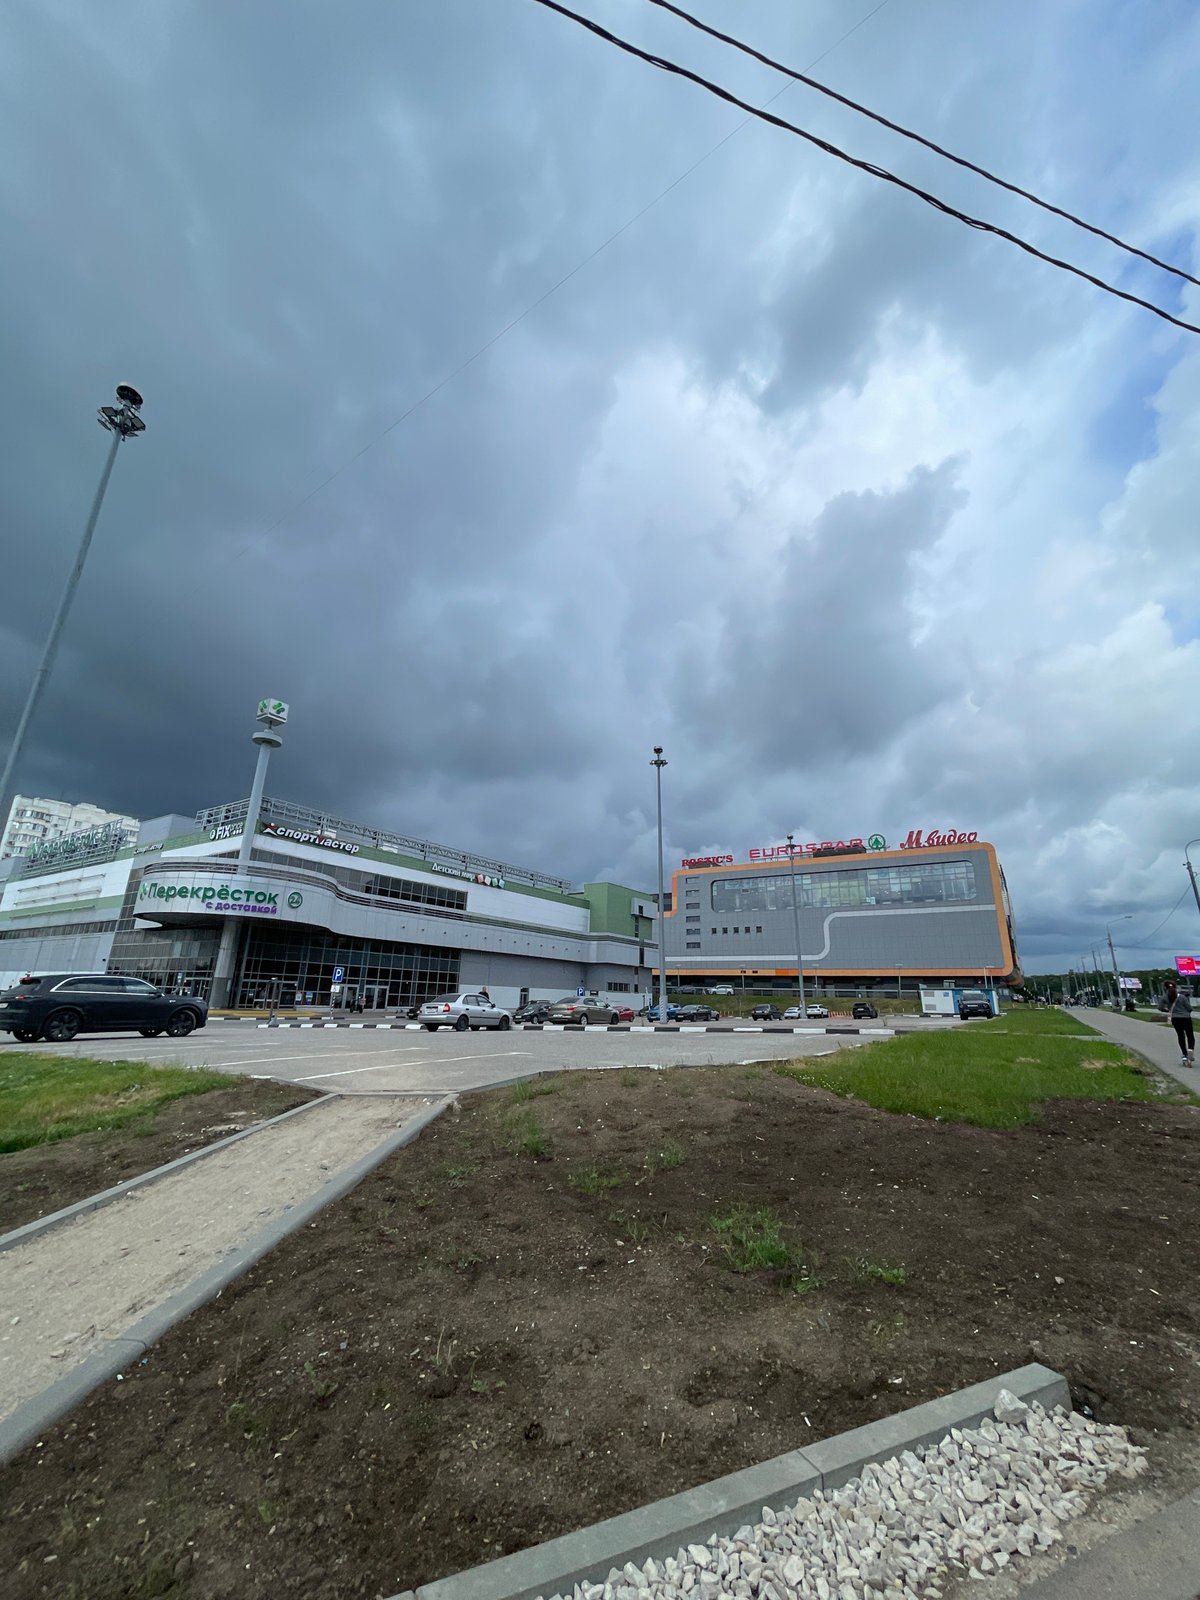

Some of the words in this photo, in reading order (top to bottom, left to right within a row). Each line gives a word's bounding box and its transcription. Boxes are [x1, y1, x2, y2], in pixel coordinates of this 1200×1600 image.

[216, 825, 230, 839] FIX
[749, 838, 863, 859] EUROSPAR
[681, 854, 733, 867] ROSTIC'S
[148, 882, 279, 905] Перекрёсток
[215, 901, 277, 914] доставкой
